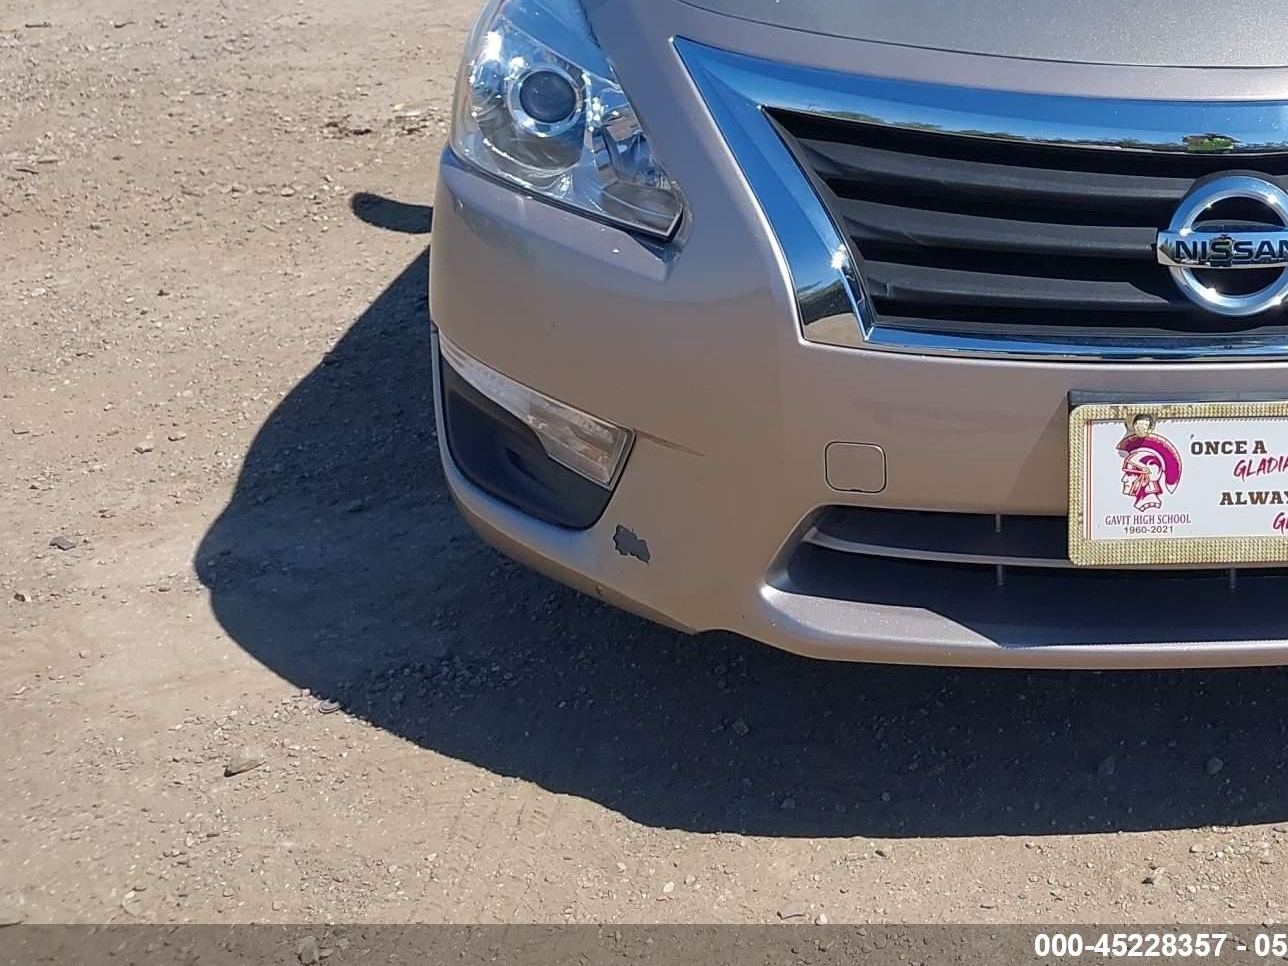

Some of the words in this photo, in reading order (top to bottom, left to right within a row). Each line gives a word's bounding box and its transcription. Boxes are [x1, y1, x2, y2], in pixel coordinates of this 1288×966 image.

[1190, 440, 1248, 455] ONCE
[1252, 440, 1267, 454] A
[1105, 515, 1131, 525] GAVIT
[1133, 514, 1155, 525] HIGH
[1157, 513, 1192, 524] SCHOOL
[1124, 525, 1173, 534] 1960-2021
